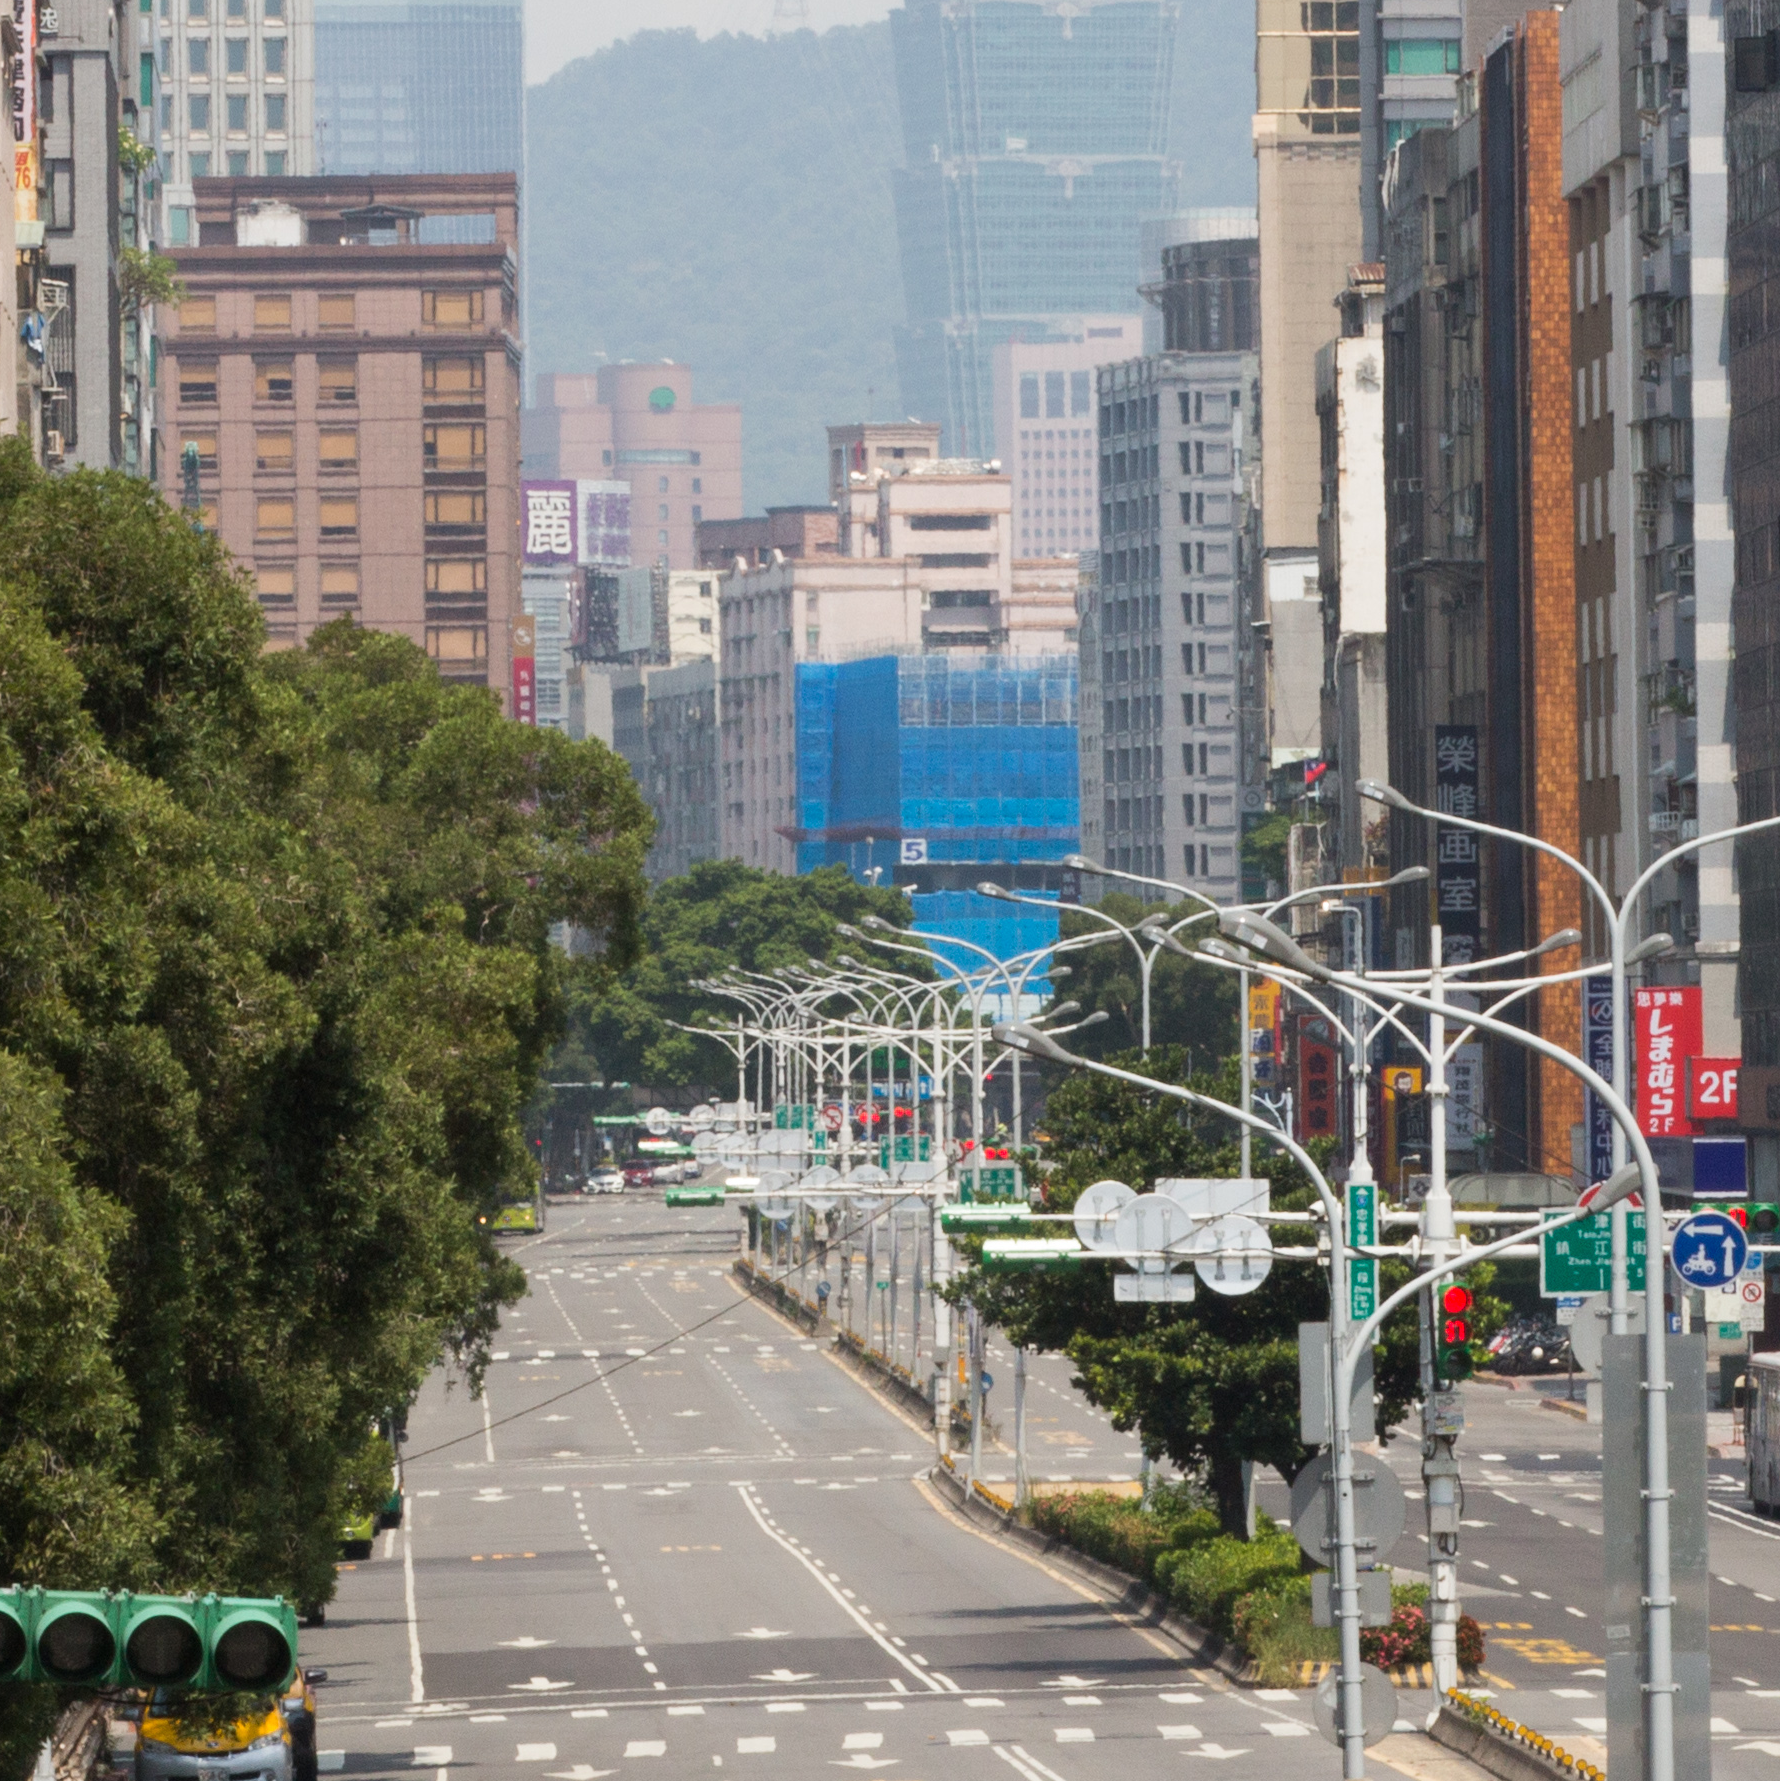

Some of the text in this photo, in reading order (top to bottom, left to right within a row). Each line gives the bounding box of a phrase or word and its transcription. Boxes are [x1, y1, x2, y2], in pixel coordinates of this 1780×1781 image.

[525, 489, 573, 555] 麗
[903, 842, 923, 862] 5
[1647, 1008, 1675, 1116] しまむら
[1699, 1070, 1738, 1104] 2F
[1649, 1117, 1675, 1134] 2F
